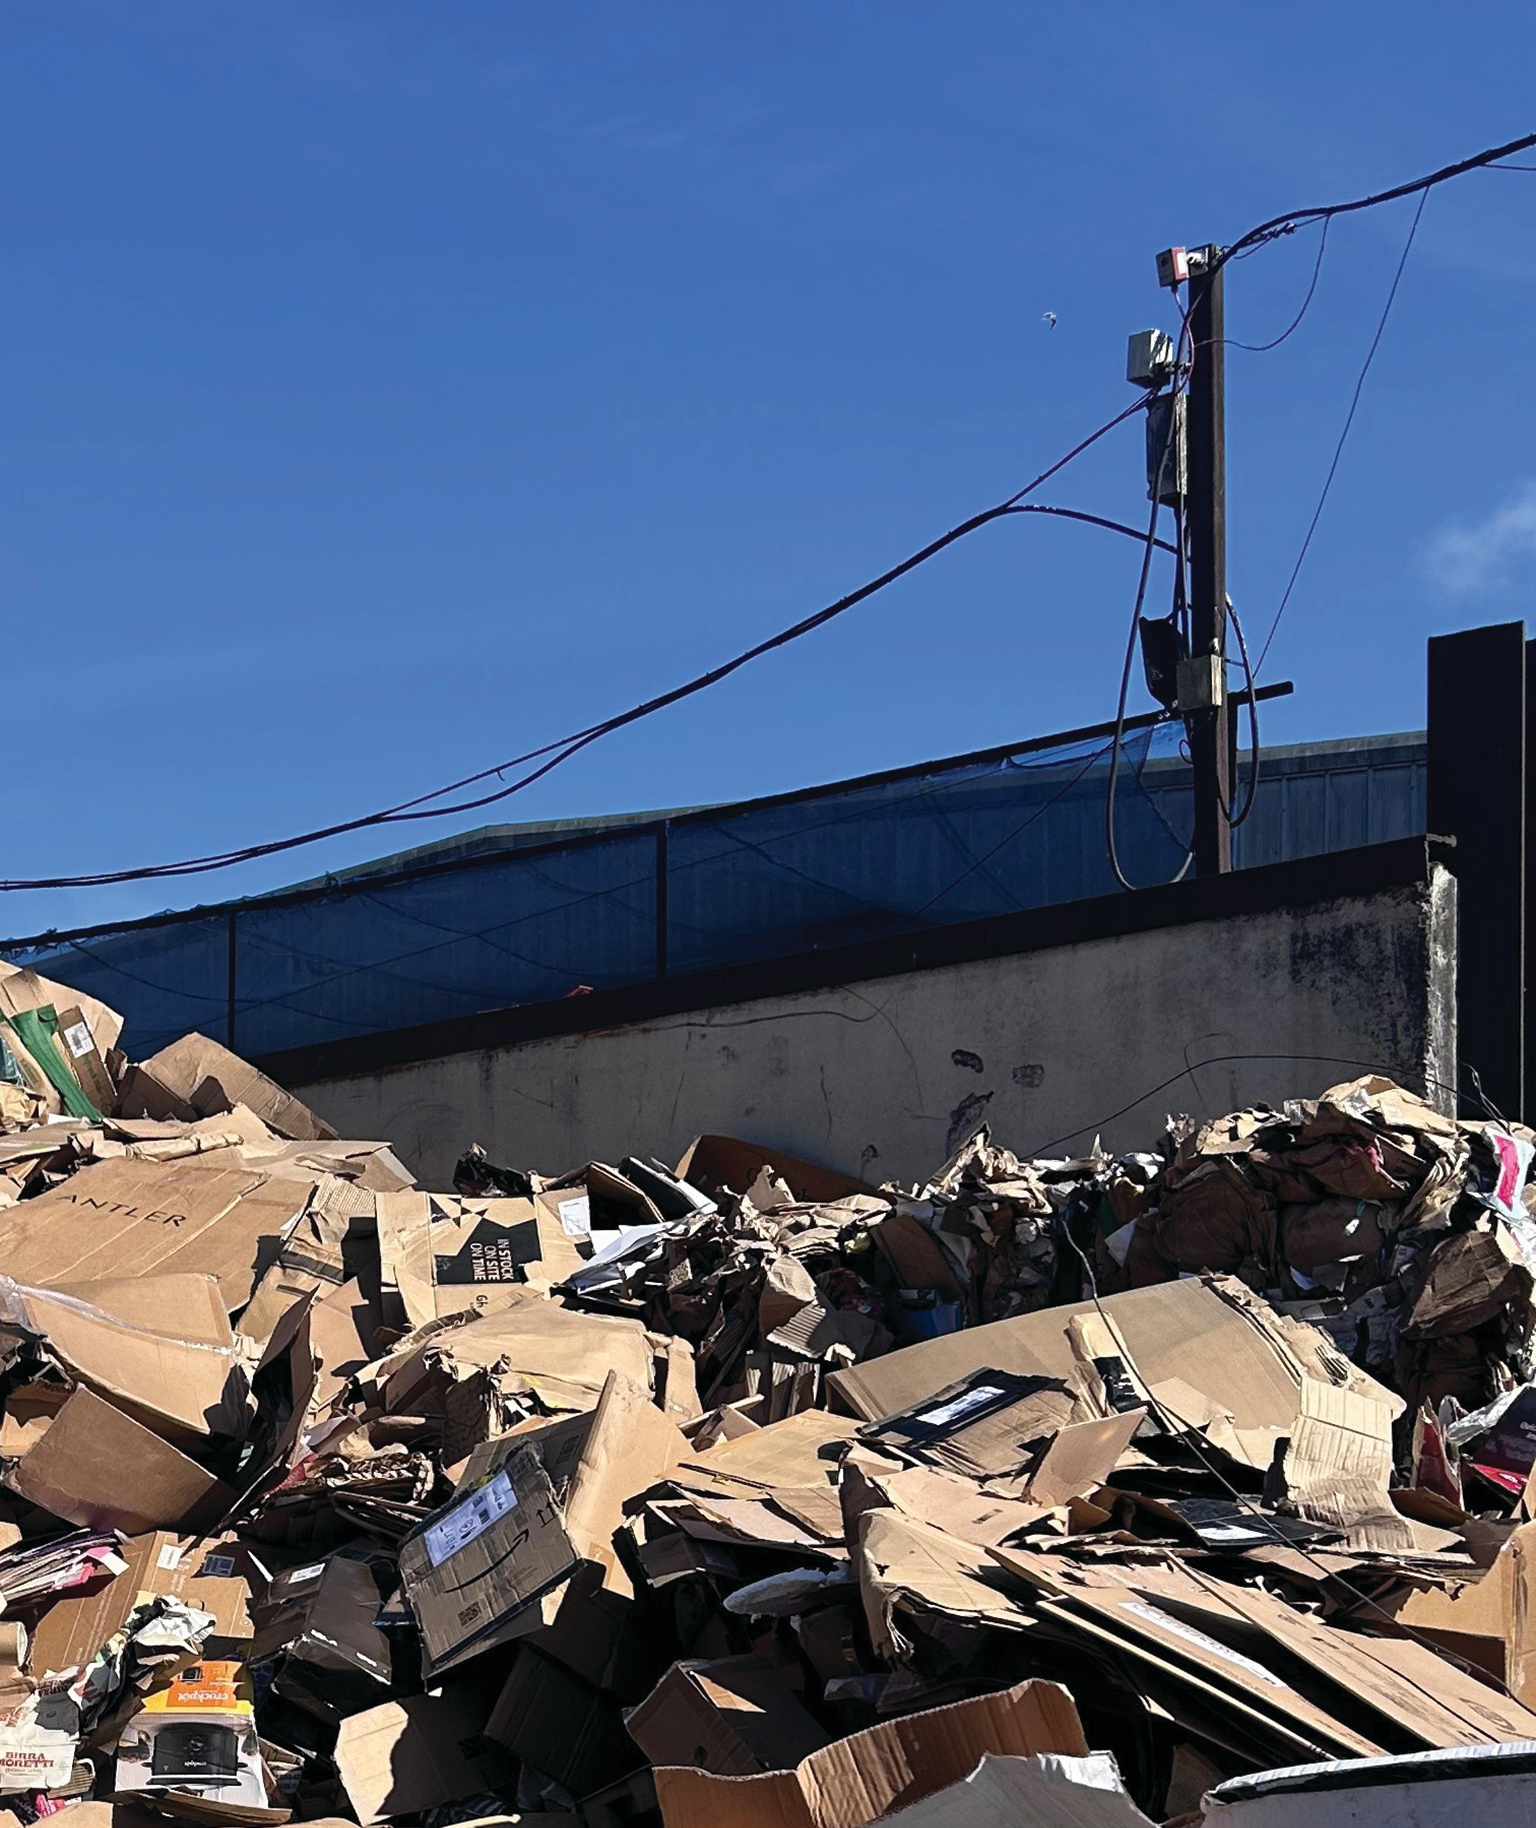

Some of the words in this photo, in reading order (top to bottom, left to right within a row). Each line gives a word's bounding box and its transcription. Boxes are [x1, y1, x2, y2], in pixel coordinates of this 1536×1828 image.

[54, 1192, 189, 1229] ANTLER
[470, 1243, 483, 1256] ON
[484, 1245, 497, 1258] ON
[498, 1238, 512, 1249] IN
[472, 1257, 484, 1281] TIME
[484, 1259, 497, 1281] SITE
[498, 1250, 514, 1281] STOCK
[5, 1751, 46, 1761] BIRRA
